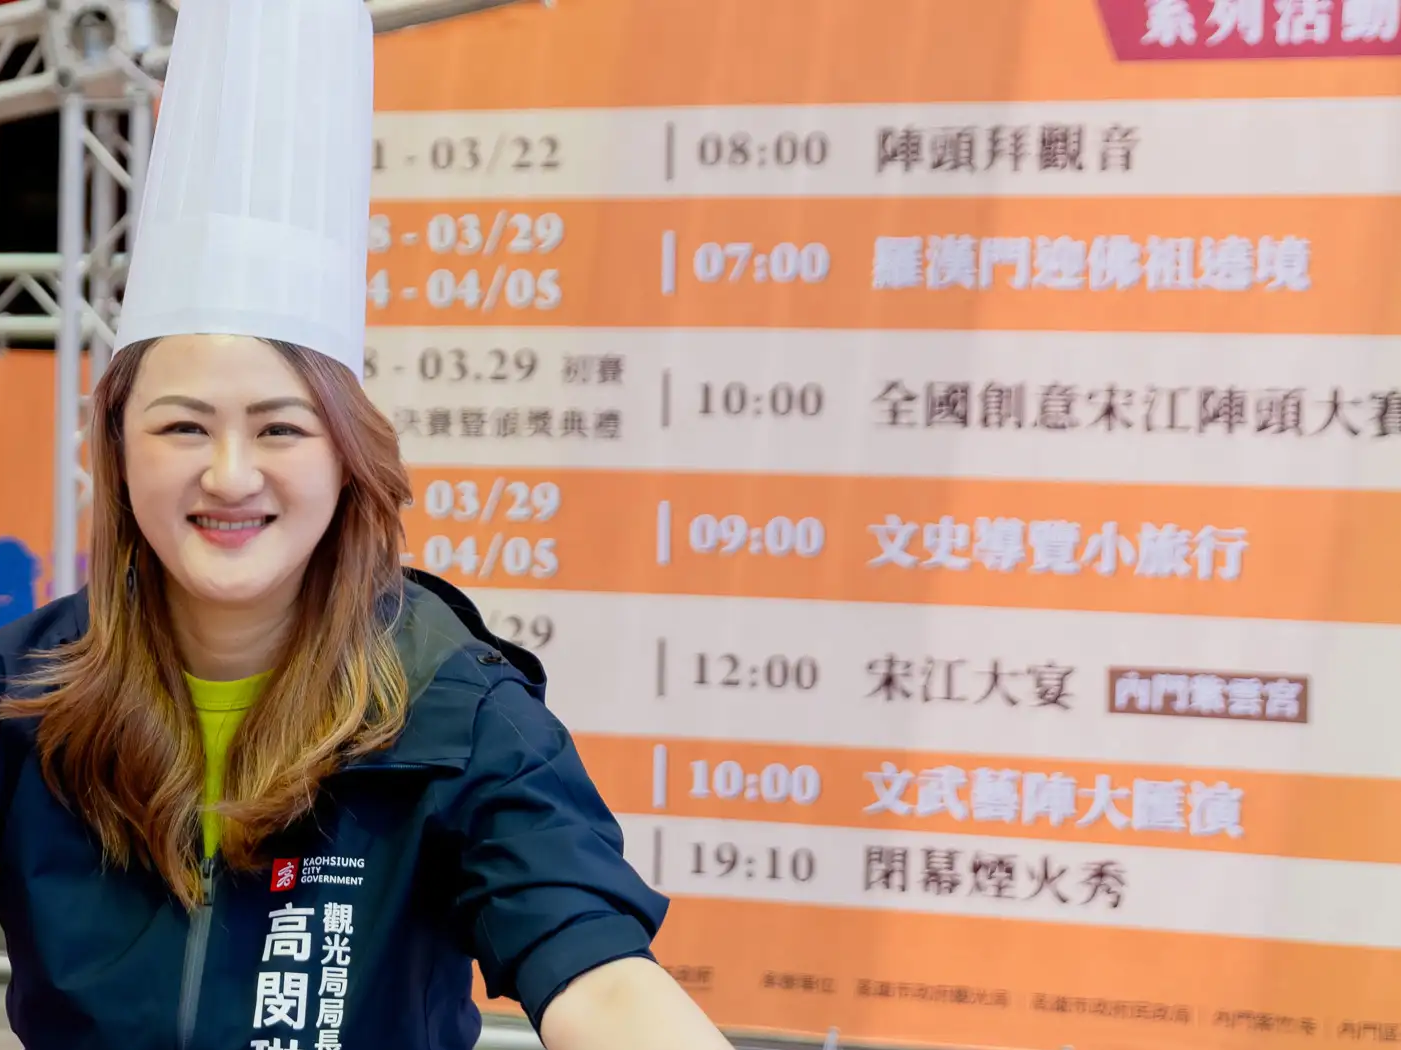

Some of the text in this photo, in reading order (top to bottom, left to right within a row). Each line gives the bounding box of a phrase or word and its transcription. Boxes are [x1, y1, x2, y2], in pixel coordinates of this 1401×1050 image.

[1140, 0, 1400, 46] 系列活動
[429, 132, 563, 175] 03/22
[697, 130, 831, 168] 08:00
[873, 122, 1143, 174] 陣頭拜觀音
[426, 210, 565, 256] 03/29
[693, 241, 832, 284] 07:00
[425, 265, 563, 313] 04/05
[417, 347, 539, 382] 03.29
[697, 381, 827, 417] 10:00
[872, 378, 1401, 440] 全國創意宋江陣頭大賽
[424, 476, 562, 525] 03/29
[423, 531, 560, 579] 04/05
[688, 513, 826, 558] 09:00
[865, 513, 1250, 582] 文史導覽小旅行
[692, 651, 820, 690] 12:00
[864, 652, 1076, 712] 宋江大宴
[688, 759, 821, 803] 10:00
[300, 874, 364, 886] GOVERNMENT
[302, 866, 321, 875] CITY
[303, 856, 365, 868] KAOHSIUNG
[688, 841, 817, 884] 19:10
[861, 844, 1128, 910] 閉幕煙火秀
